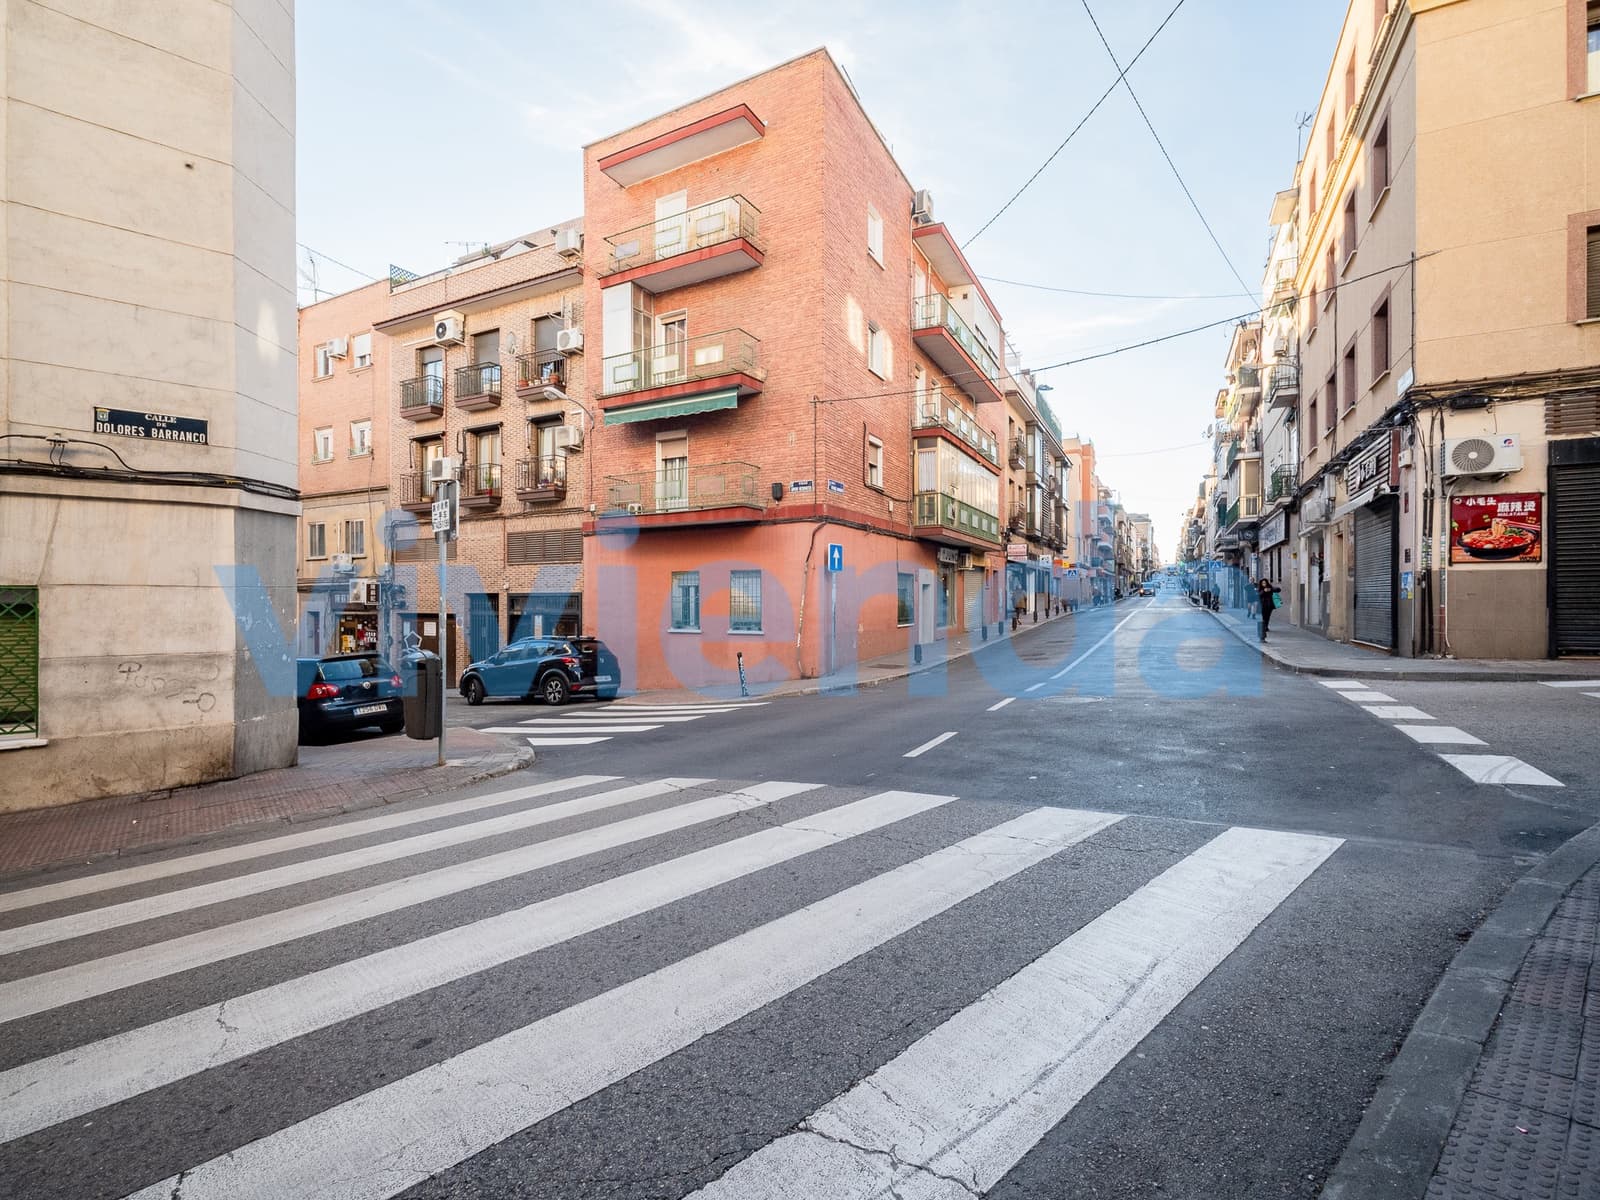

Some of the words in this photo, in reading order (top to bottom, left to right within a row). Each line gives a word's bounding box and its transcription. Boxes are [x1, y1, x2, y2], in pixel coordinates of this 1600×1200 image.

[145, 414, 177, 424] CALLE
[96, 421, 145, 437] DOLORES
[151, 427, 206, 443] BARRANCO
[1497, 501, 1536, 513] 麻辣烫
